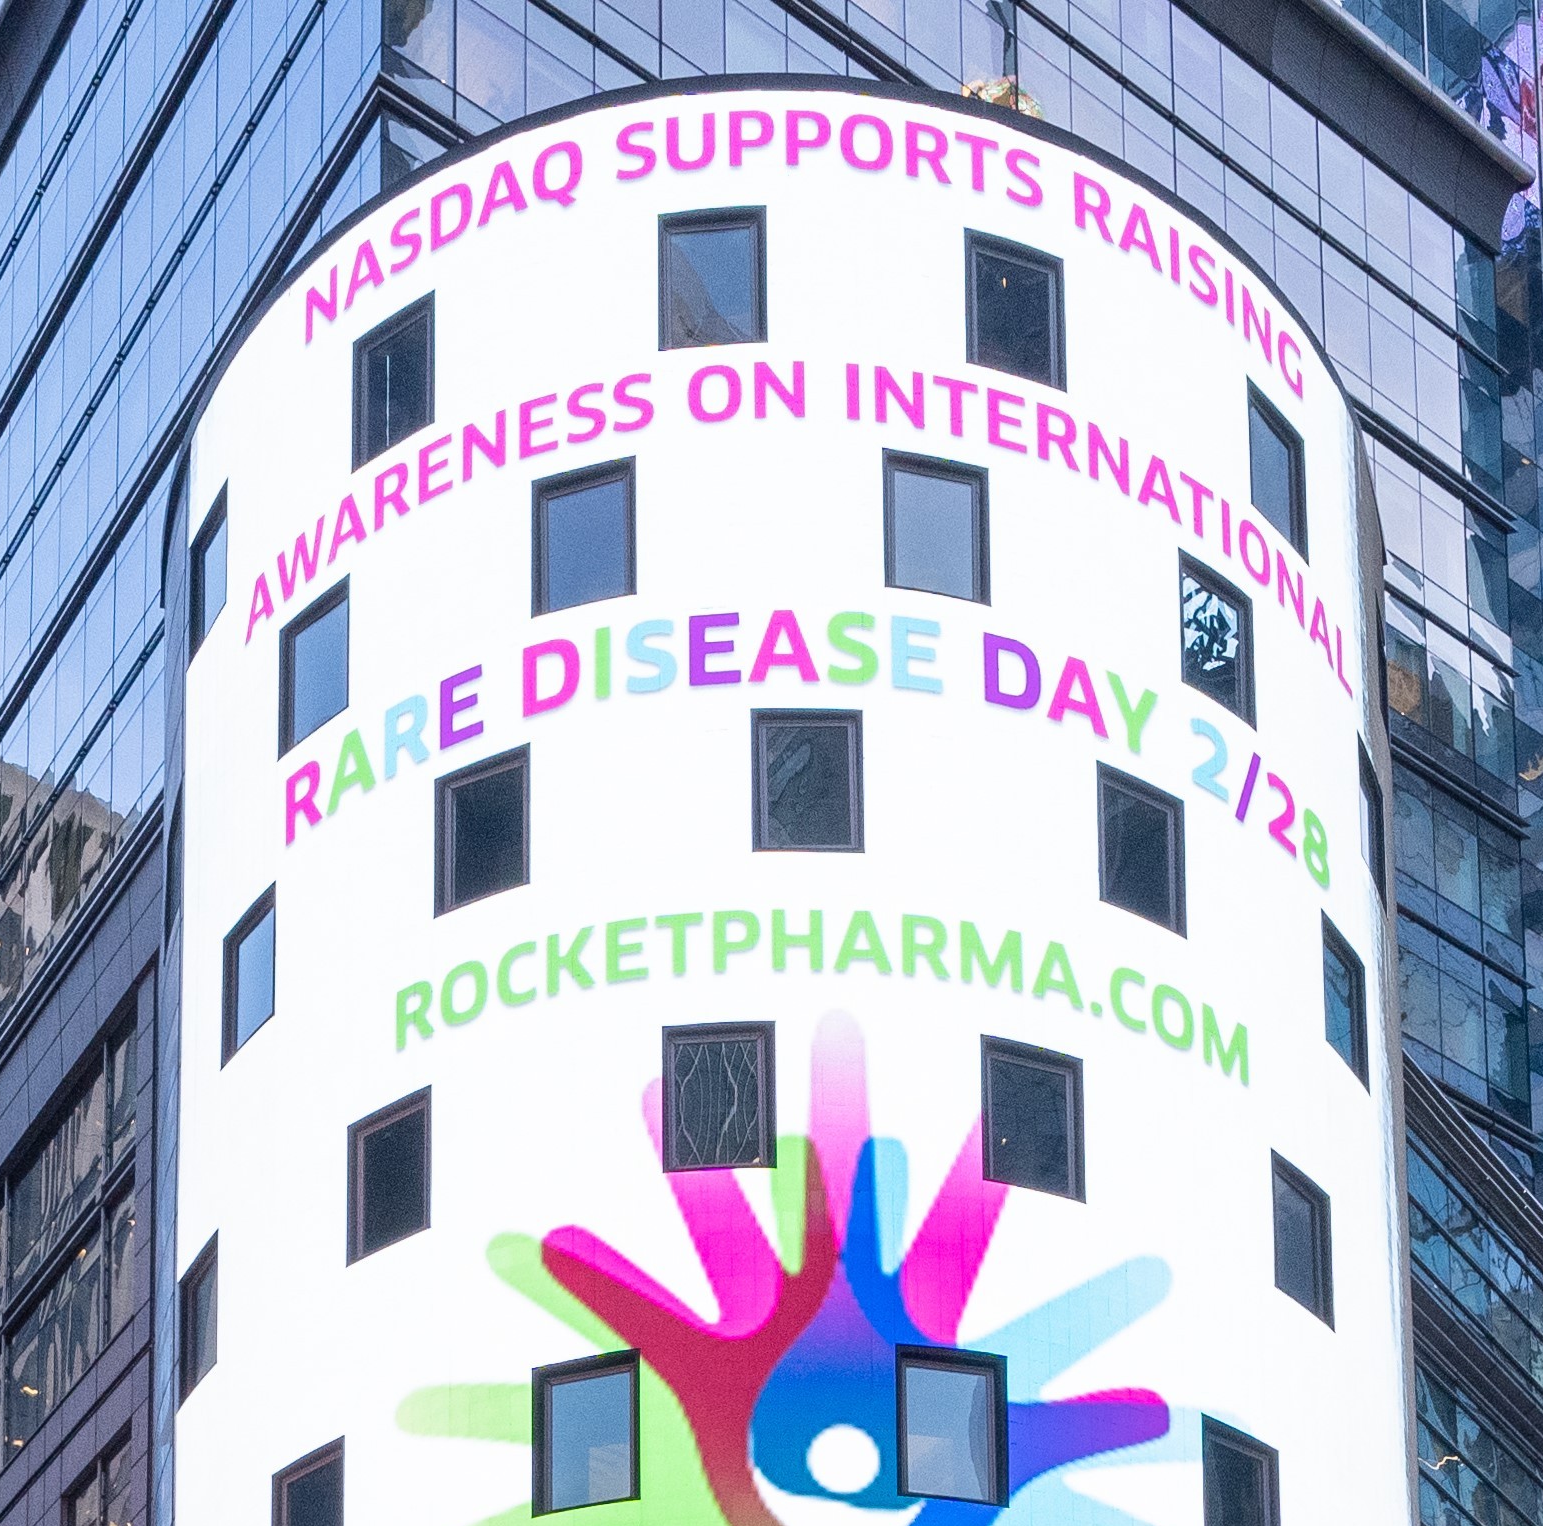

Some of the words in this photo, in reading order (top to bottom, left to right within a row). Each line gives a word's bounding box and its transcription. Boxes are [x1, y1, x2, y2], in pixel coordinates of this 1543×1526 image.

[304, 139, 584, 345] NASDAQ
[614, 108, 1044, 207] SUPPORTS
[1071, 170, 1307, 400] RAISING
[243, 371, 655, 644] AWARENESS
[687, 360, 807, 423] ON
[846, 361, 1355, 700] INTERNATIONAL
[282, 662, 484, 845] RARE
[521, 611, 944, 716] DISEASE
[982, 632, 1159, 754] DAY
[1191, 717, 1330, 889] 2/28
[394, 908, 1251, 1086] ROCKETPHARMA.COM
